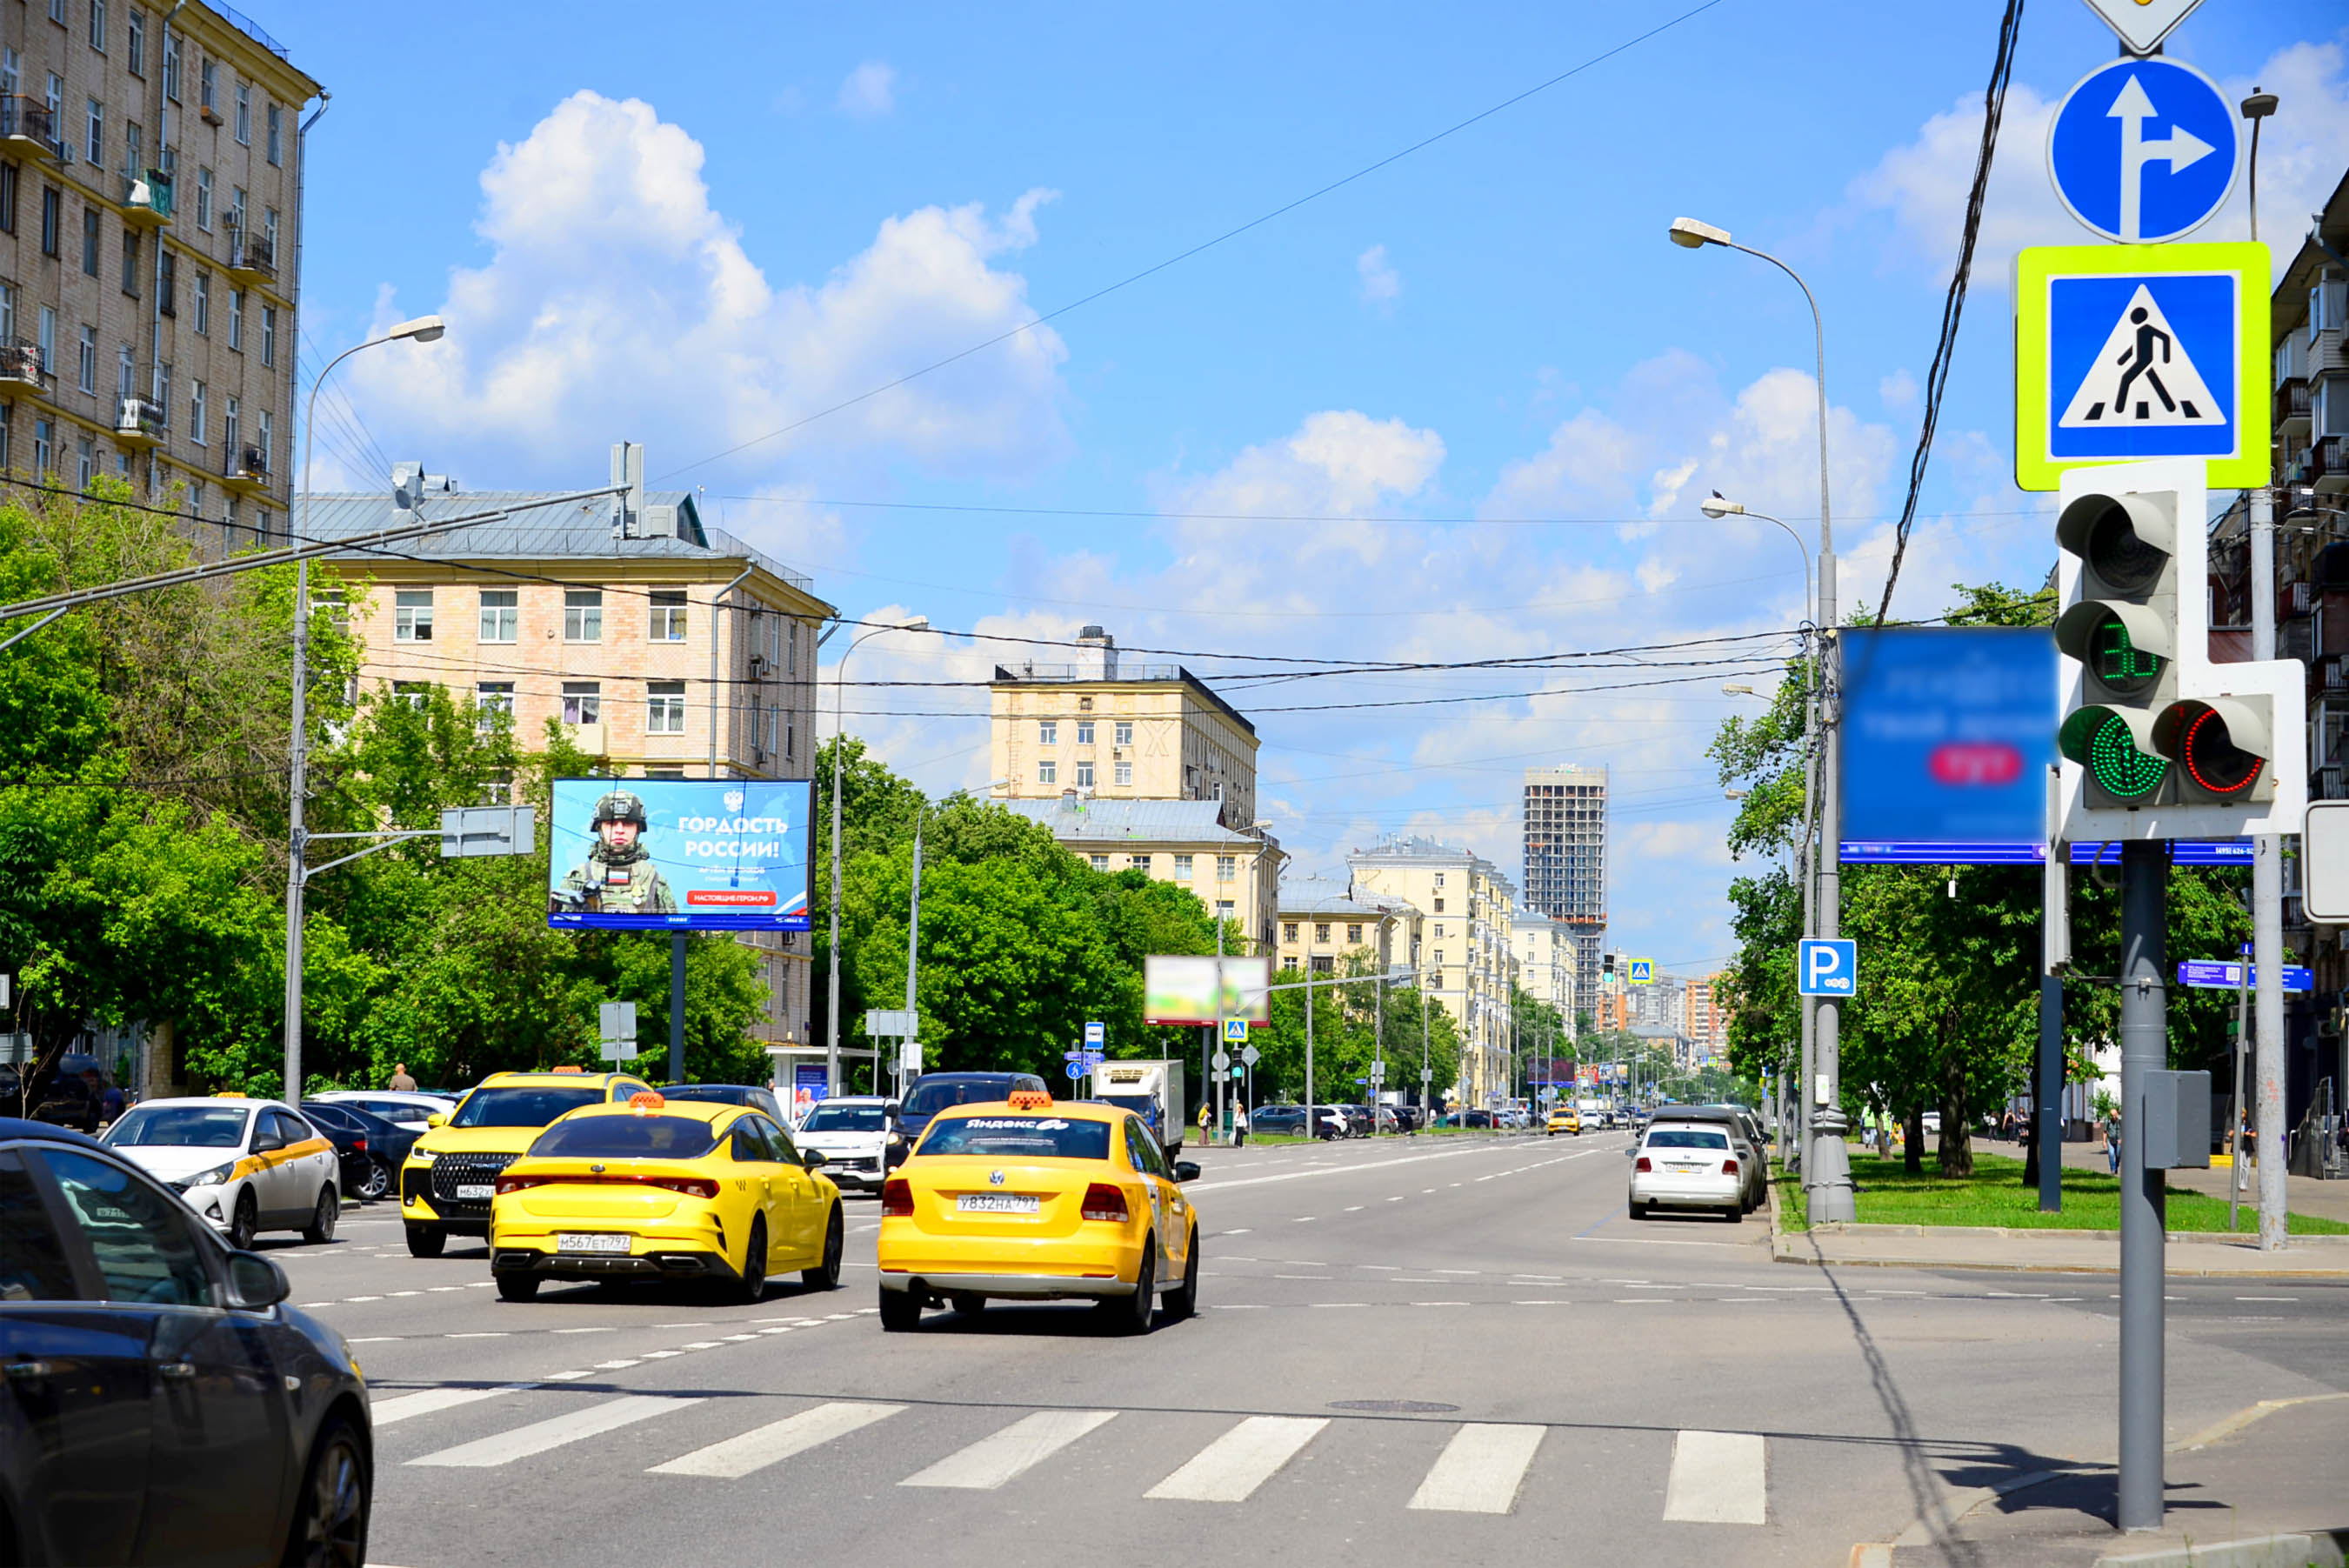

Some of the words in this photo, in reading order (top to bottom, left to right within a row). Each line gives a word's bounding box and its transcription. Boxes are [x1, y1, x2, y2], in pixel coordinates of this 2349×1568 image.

[678, 816, 788, 835] ГОРДОСТЬ
[685, 840, 780, 857] РОССИИ!
[1809, 945, 1839, 989] P
[965, 1118, 1037, 1129] Яндекс
